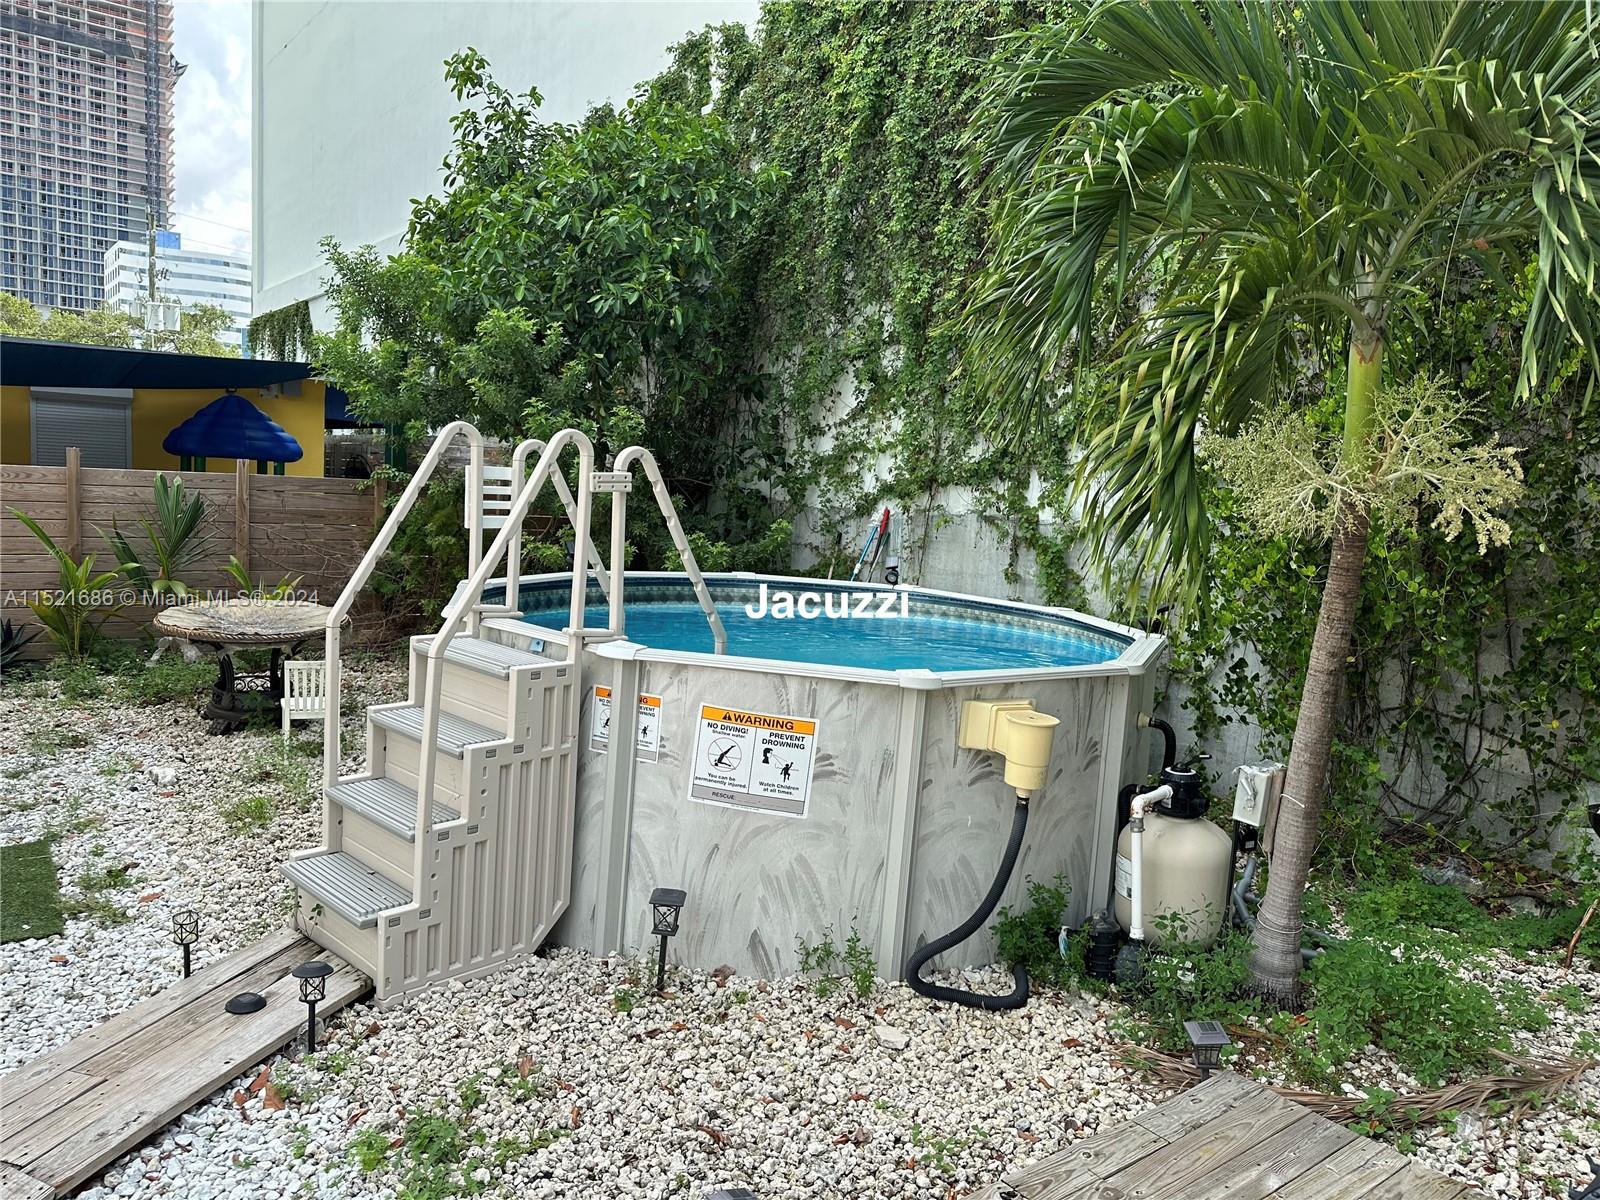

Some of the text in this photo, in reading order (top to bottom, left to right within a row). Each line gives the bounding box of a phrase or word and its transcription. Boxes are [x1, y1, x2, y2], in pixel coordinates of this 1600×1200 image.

[733, 713, 794, 731] WARNING
[720, 724, 749, 735] DIVING!
[769, 732, 806, 742] PREVENT
[761, 738, 806, 750] DROWNING
[695, 776, 727, 786] permanently
